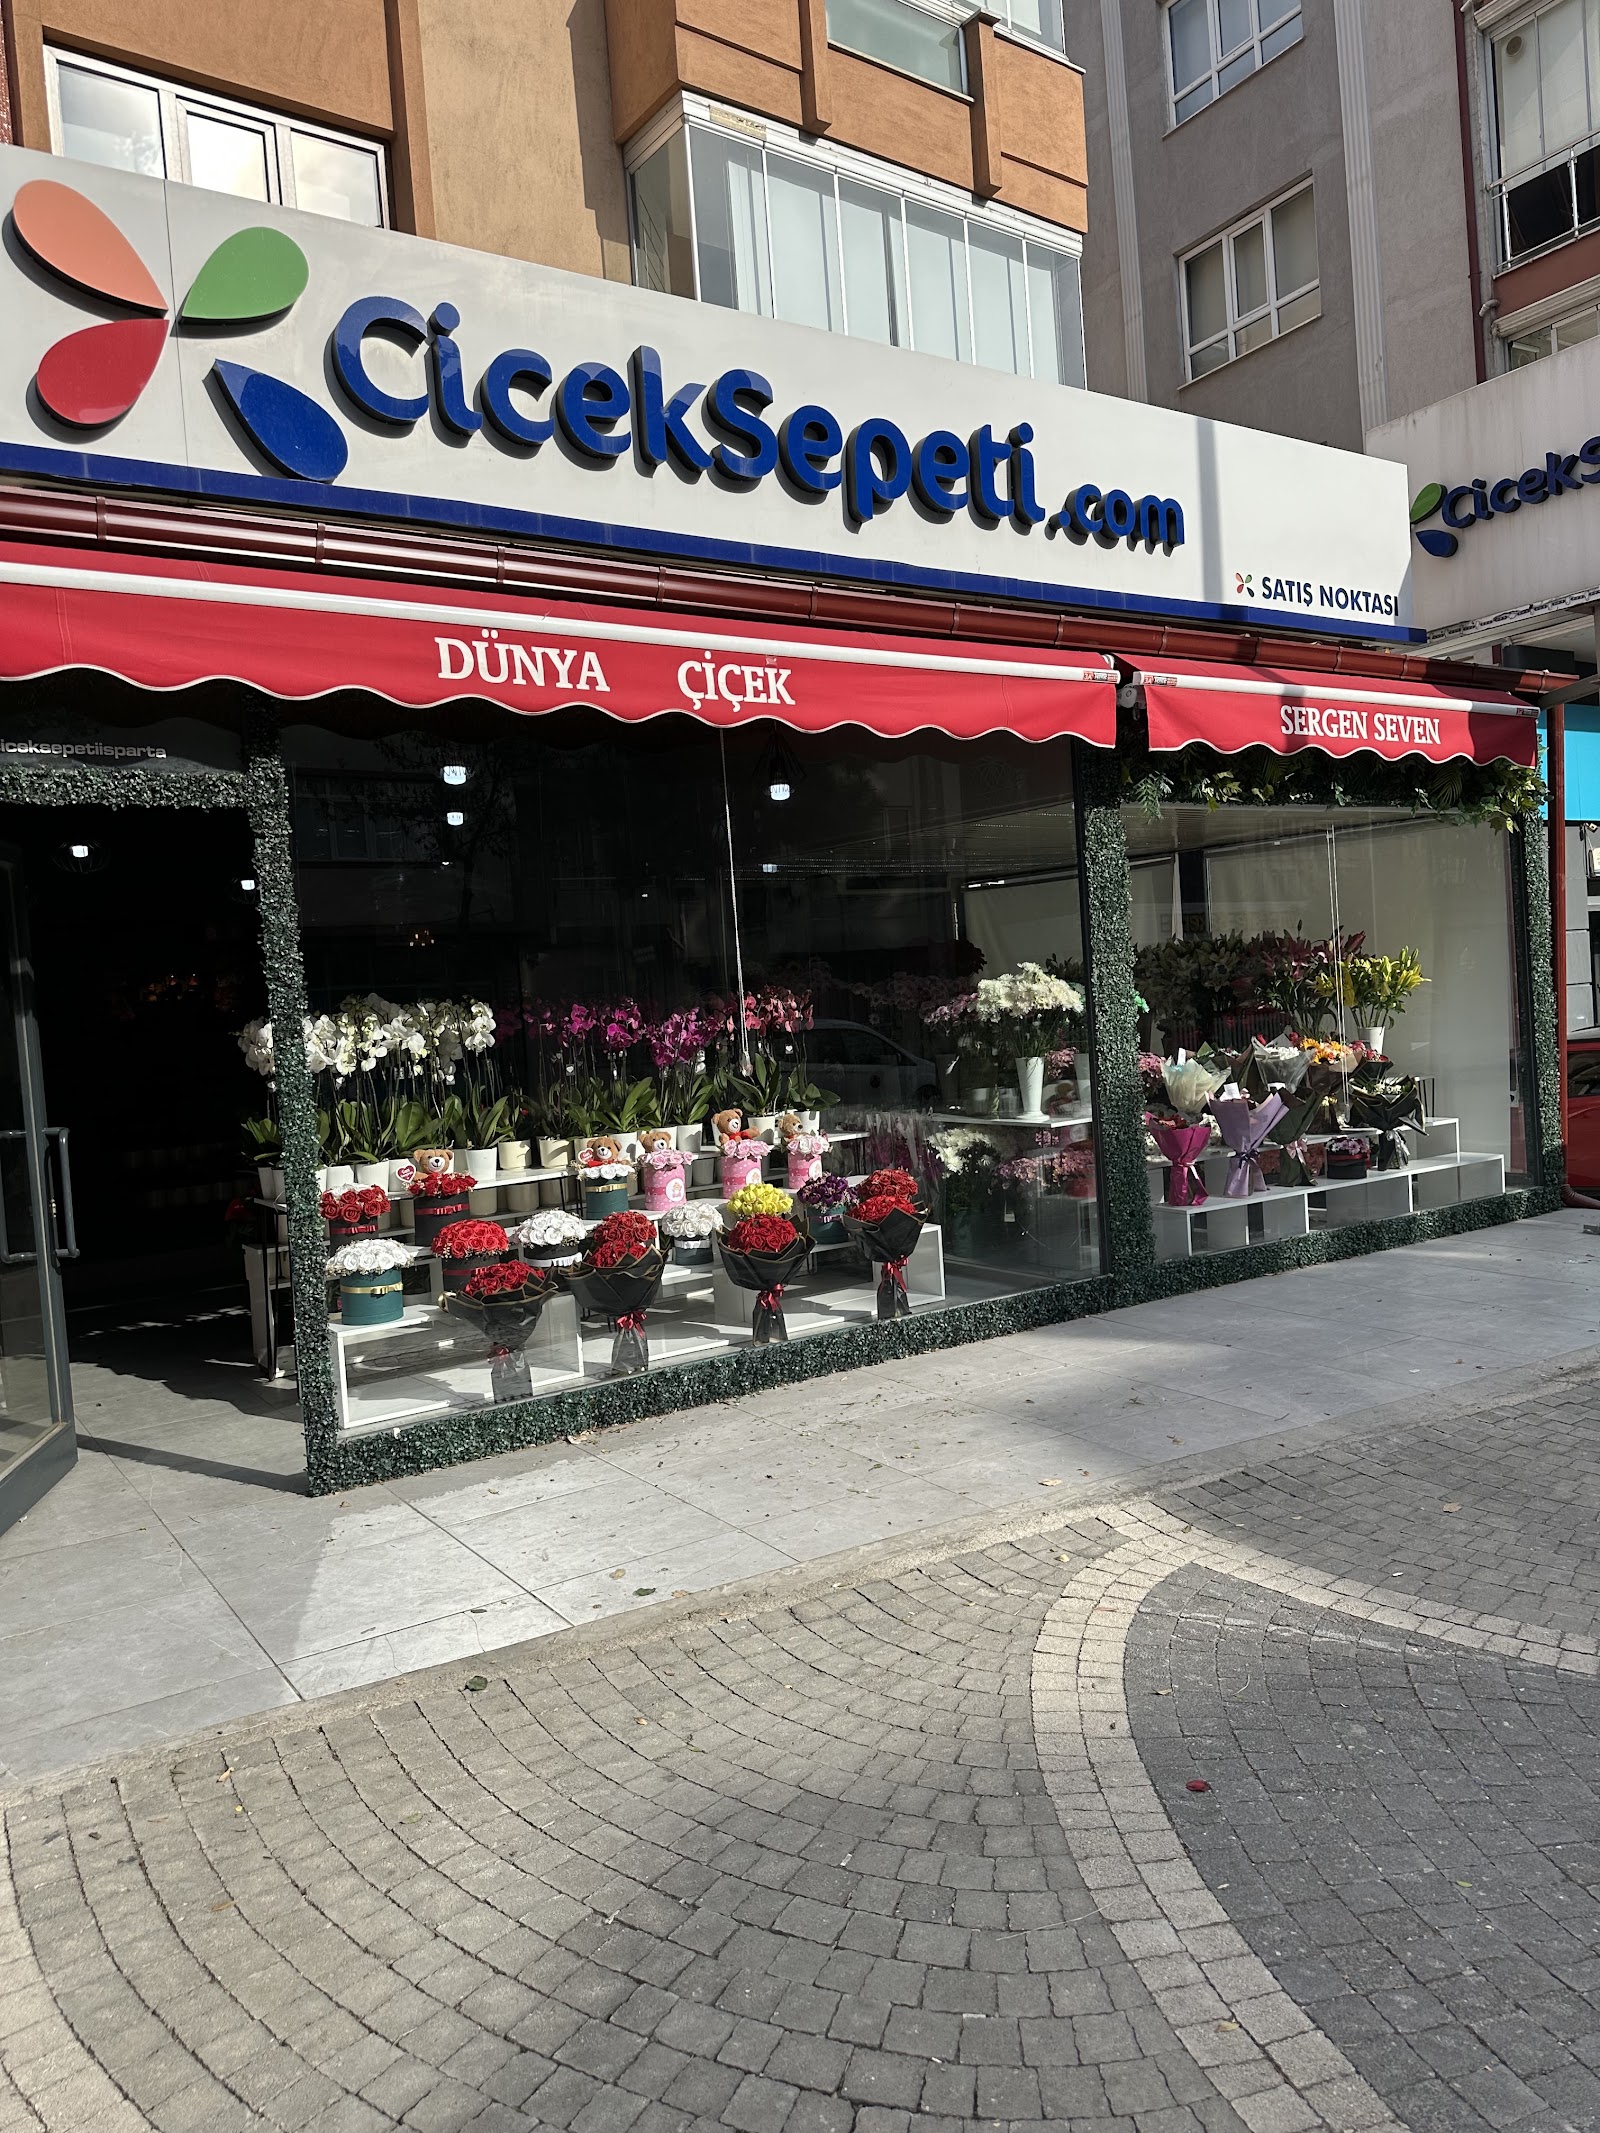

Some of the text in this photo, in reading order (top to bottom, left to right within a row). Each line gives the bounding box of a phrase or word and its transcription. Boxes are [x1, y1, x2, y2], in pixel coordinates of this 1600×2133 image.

[1262, 576, 1399, 616] SATIŞ NOKTASI
[434, 629, 796, 712] DÜNYA ÇİÇEK
[1280, 705, 1441, 744] SERGEN SEVEN
[0, 738, 167, 759] iceksepetiisparta
